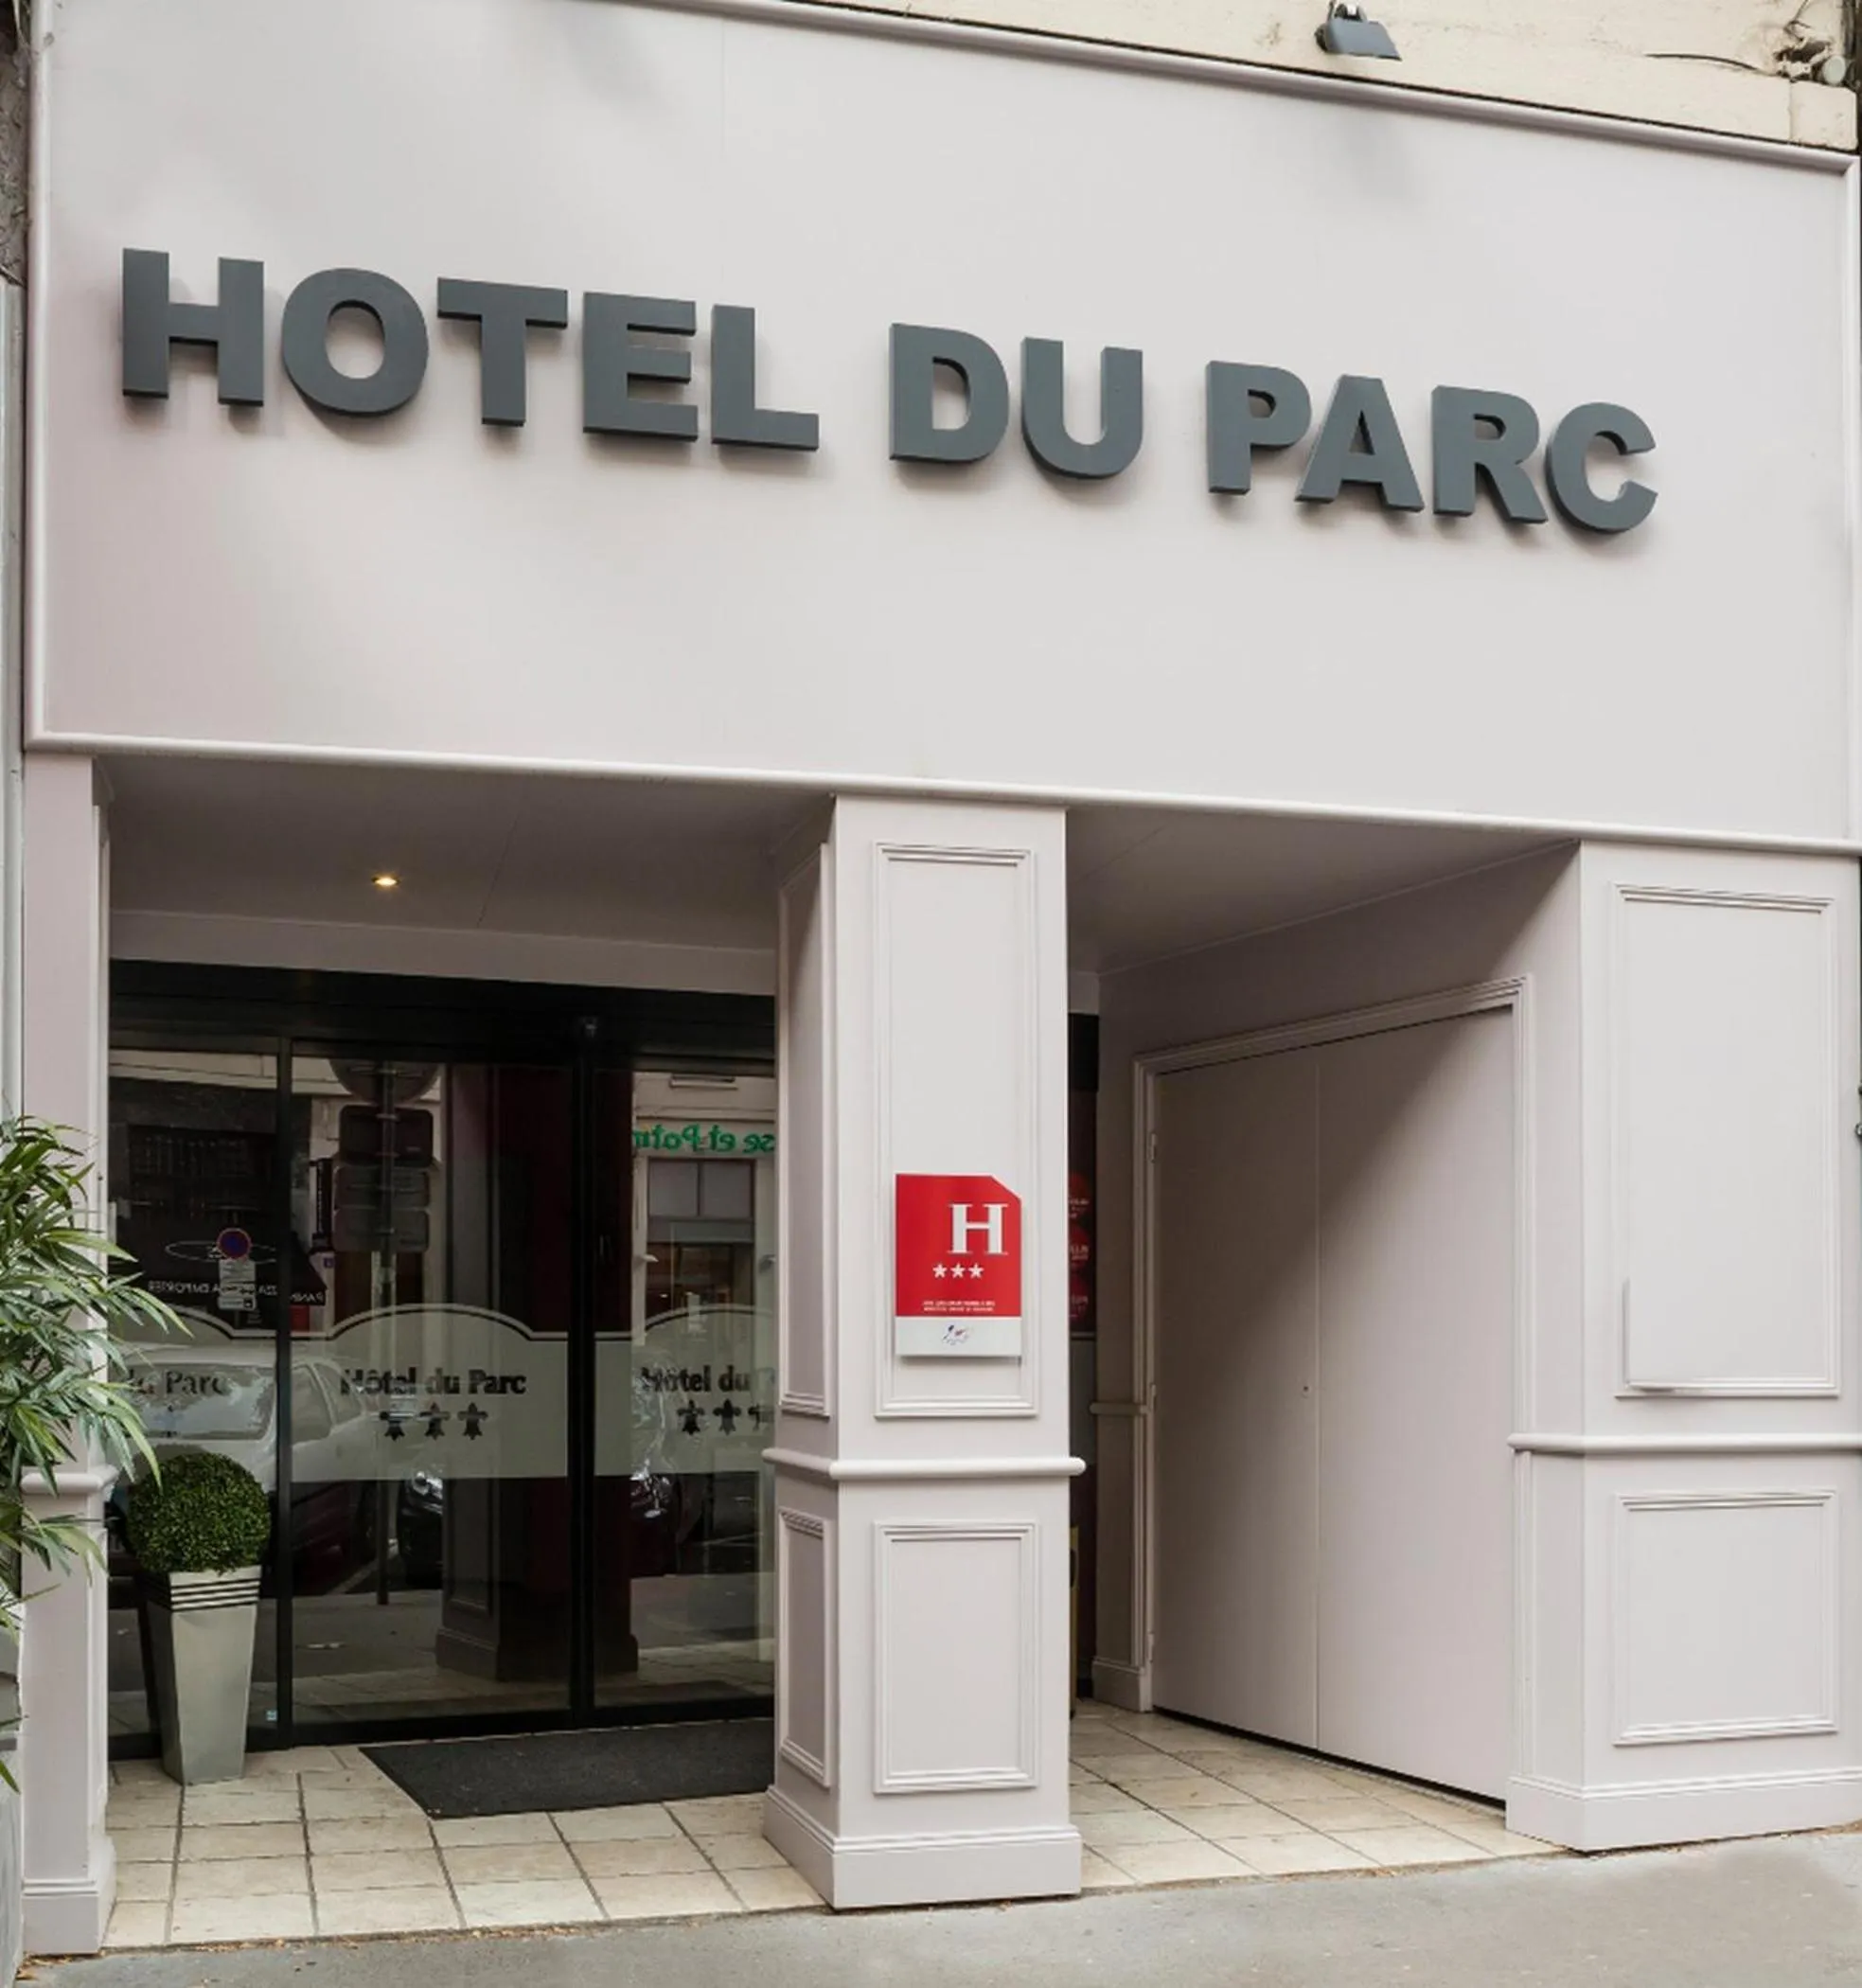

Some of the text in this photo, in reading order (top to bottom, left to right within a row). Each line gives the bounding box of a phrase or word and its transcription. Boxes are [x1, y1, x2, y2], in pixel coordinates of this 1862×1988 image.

[123, 248, 1658, 534] HOTEL DU PARC
[948, 1203, 1008, 1255] H
[341, 1367, 528, 1394] Hôtel du Parc
[718, 1364, 752, 1393] du
